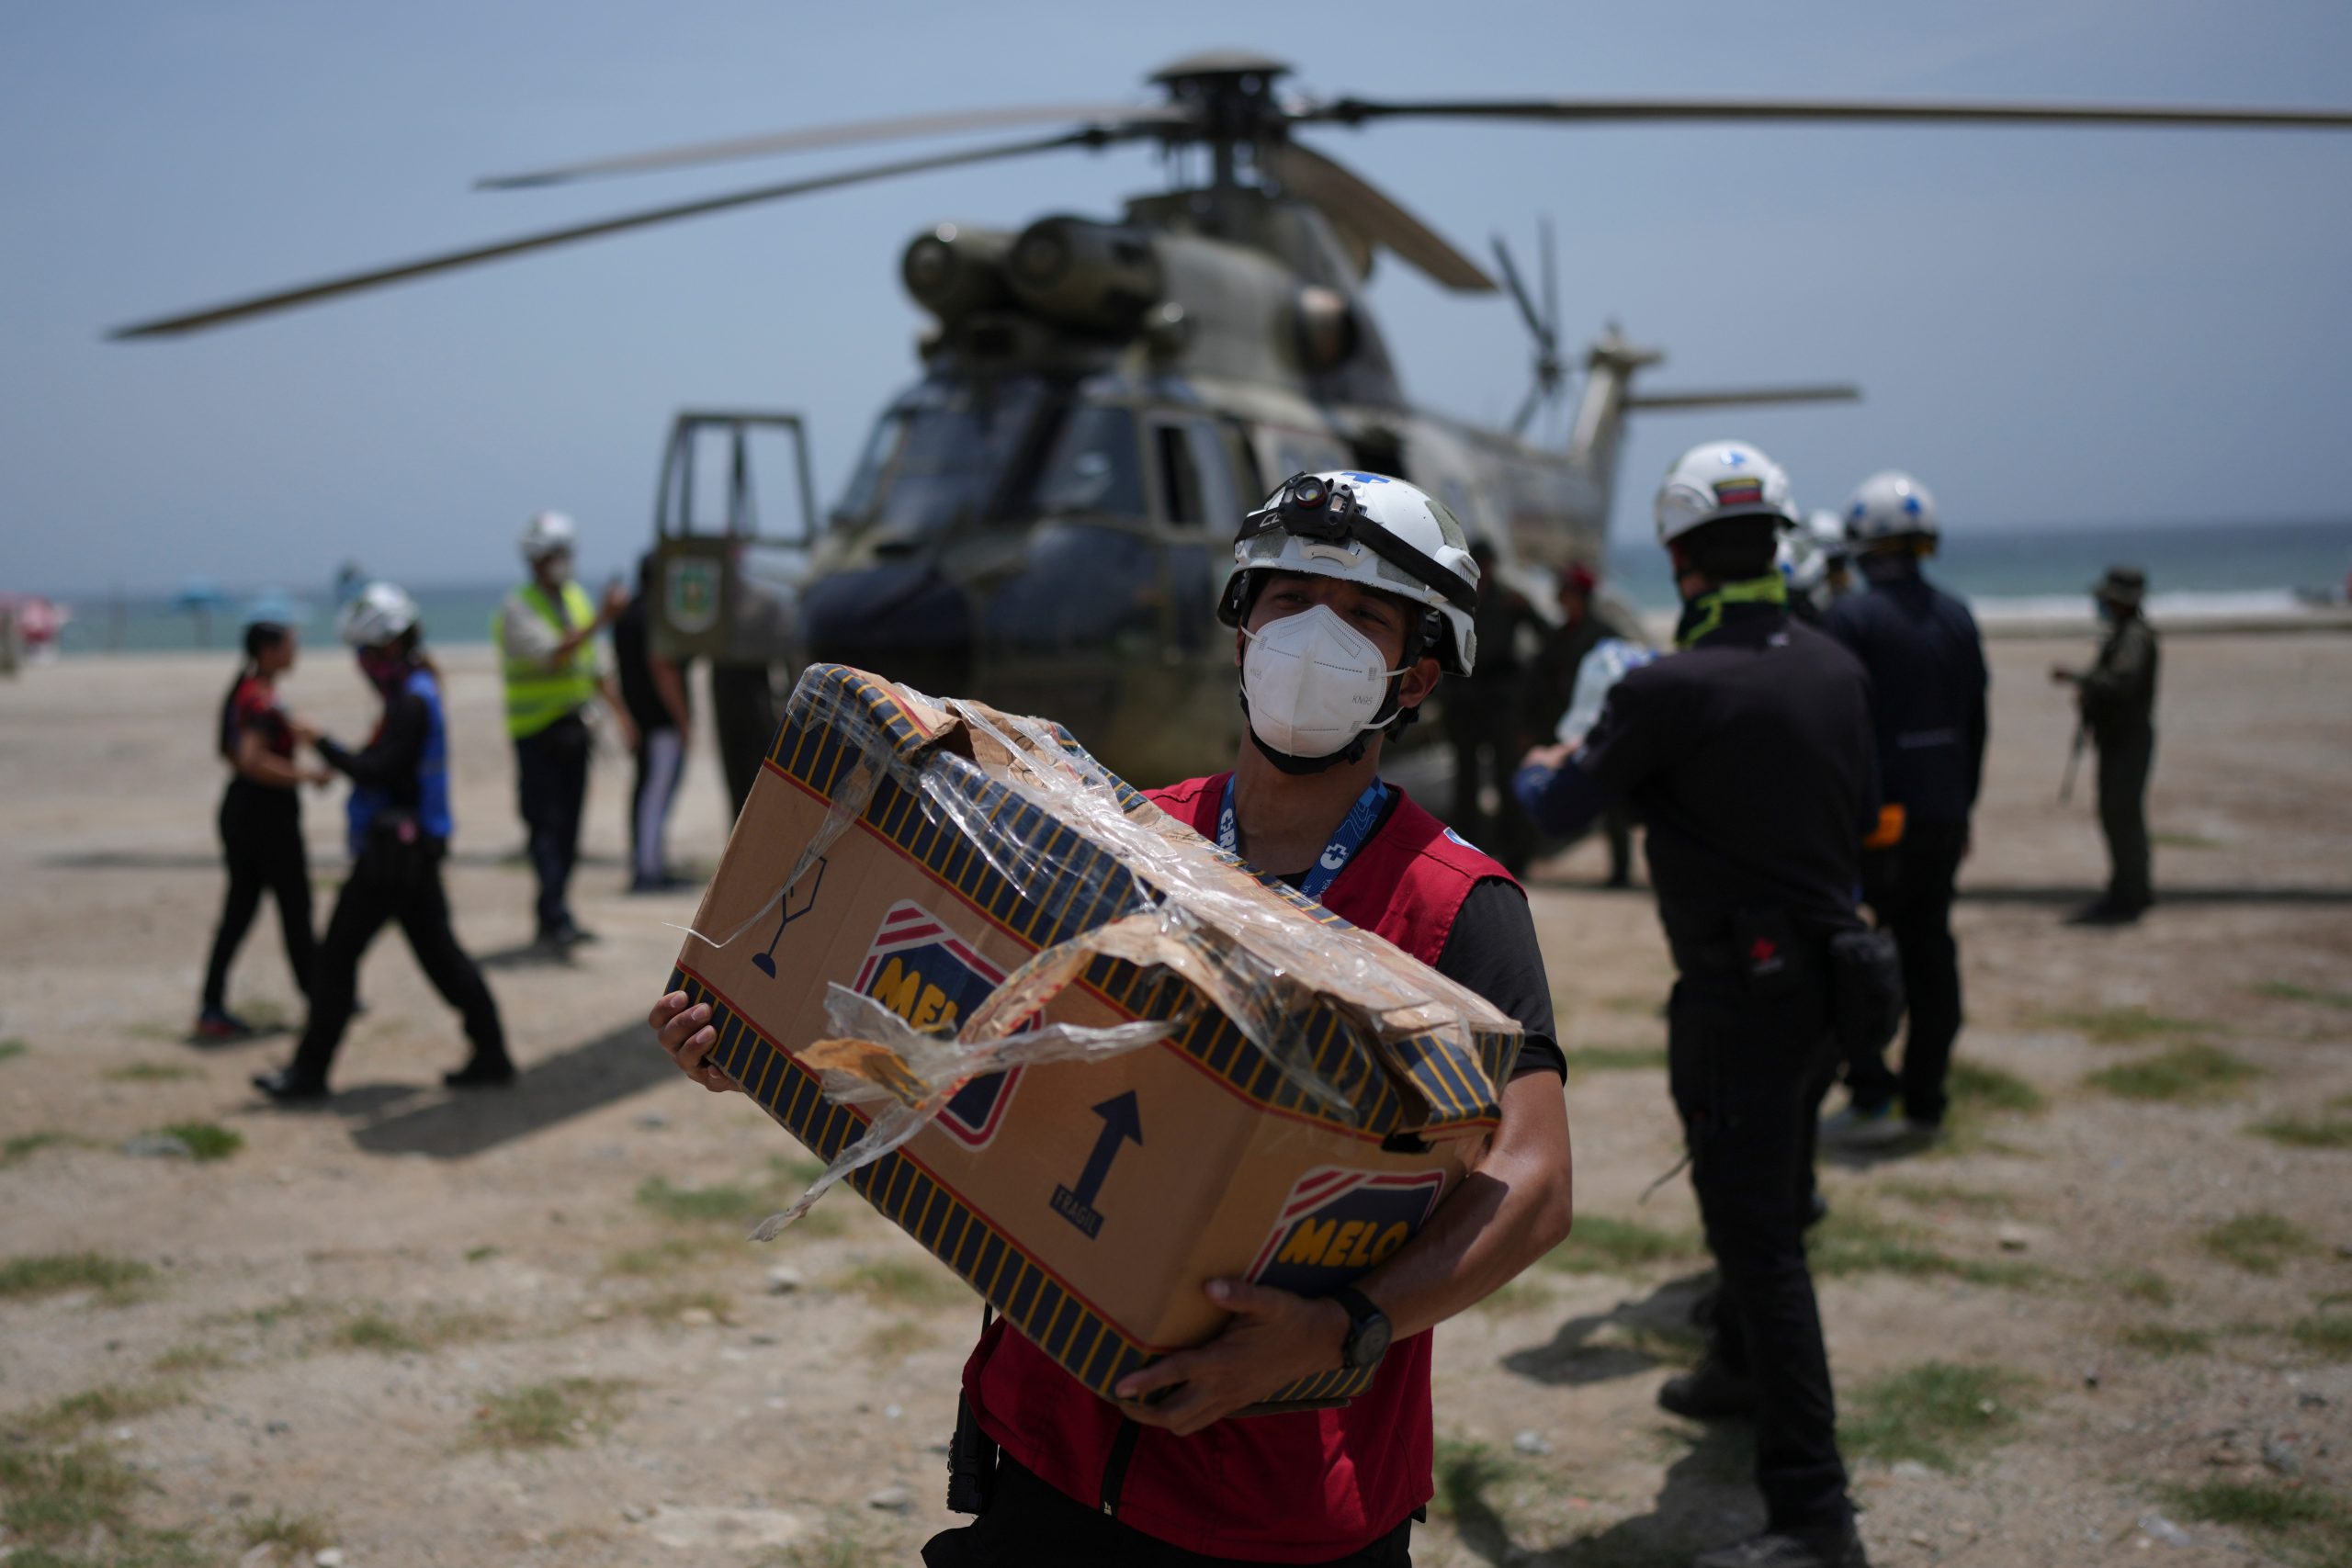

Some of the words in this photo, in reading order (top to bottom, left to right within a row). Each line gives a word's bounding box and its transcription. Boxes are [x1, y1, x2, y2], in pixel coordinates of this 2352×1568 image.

[1351, 694, 1374, 705] KN95
[872, 956, 958, 1030] MEL
[1277, 1217, 1408, 1268] MELO
